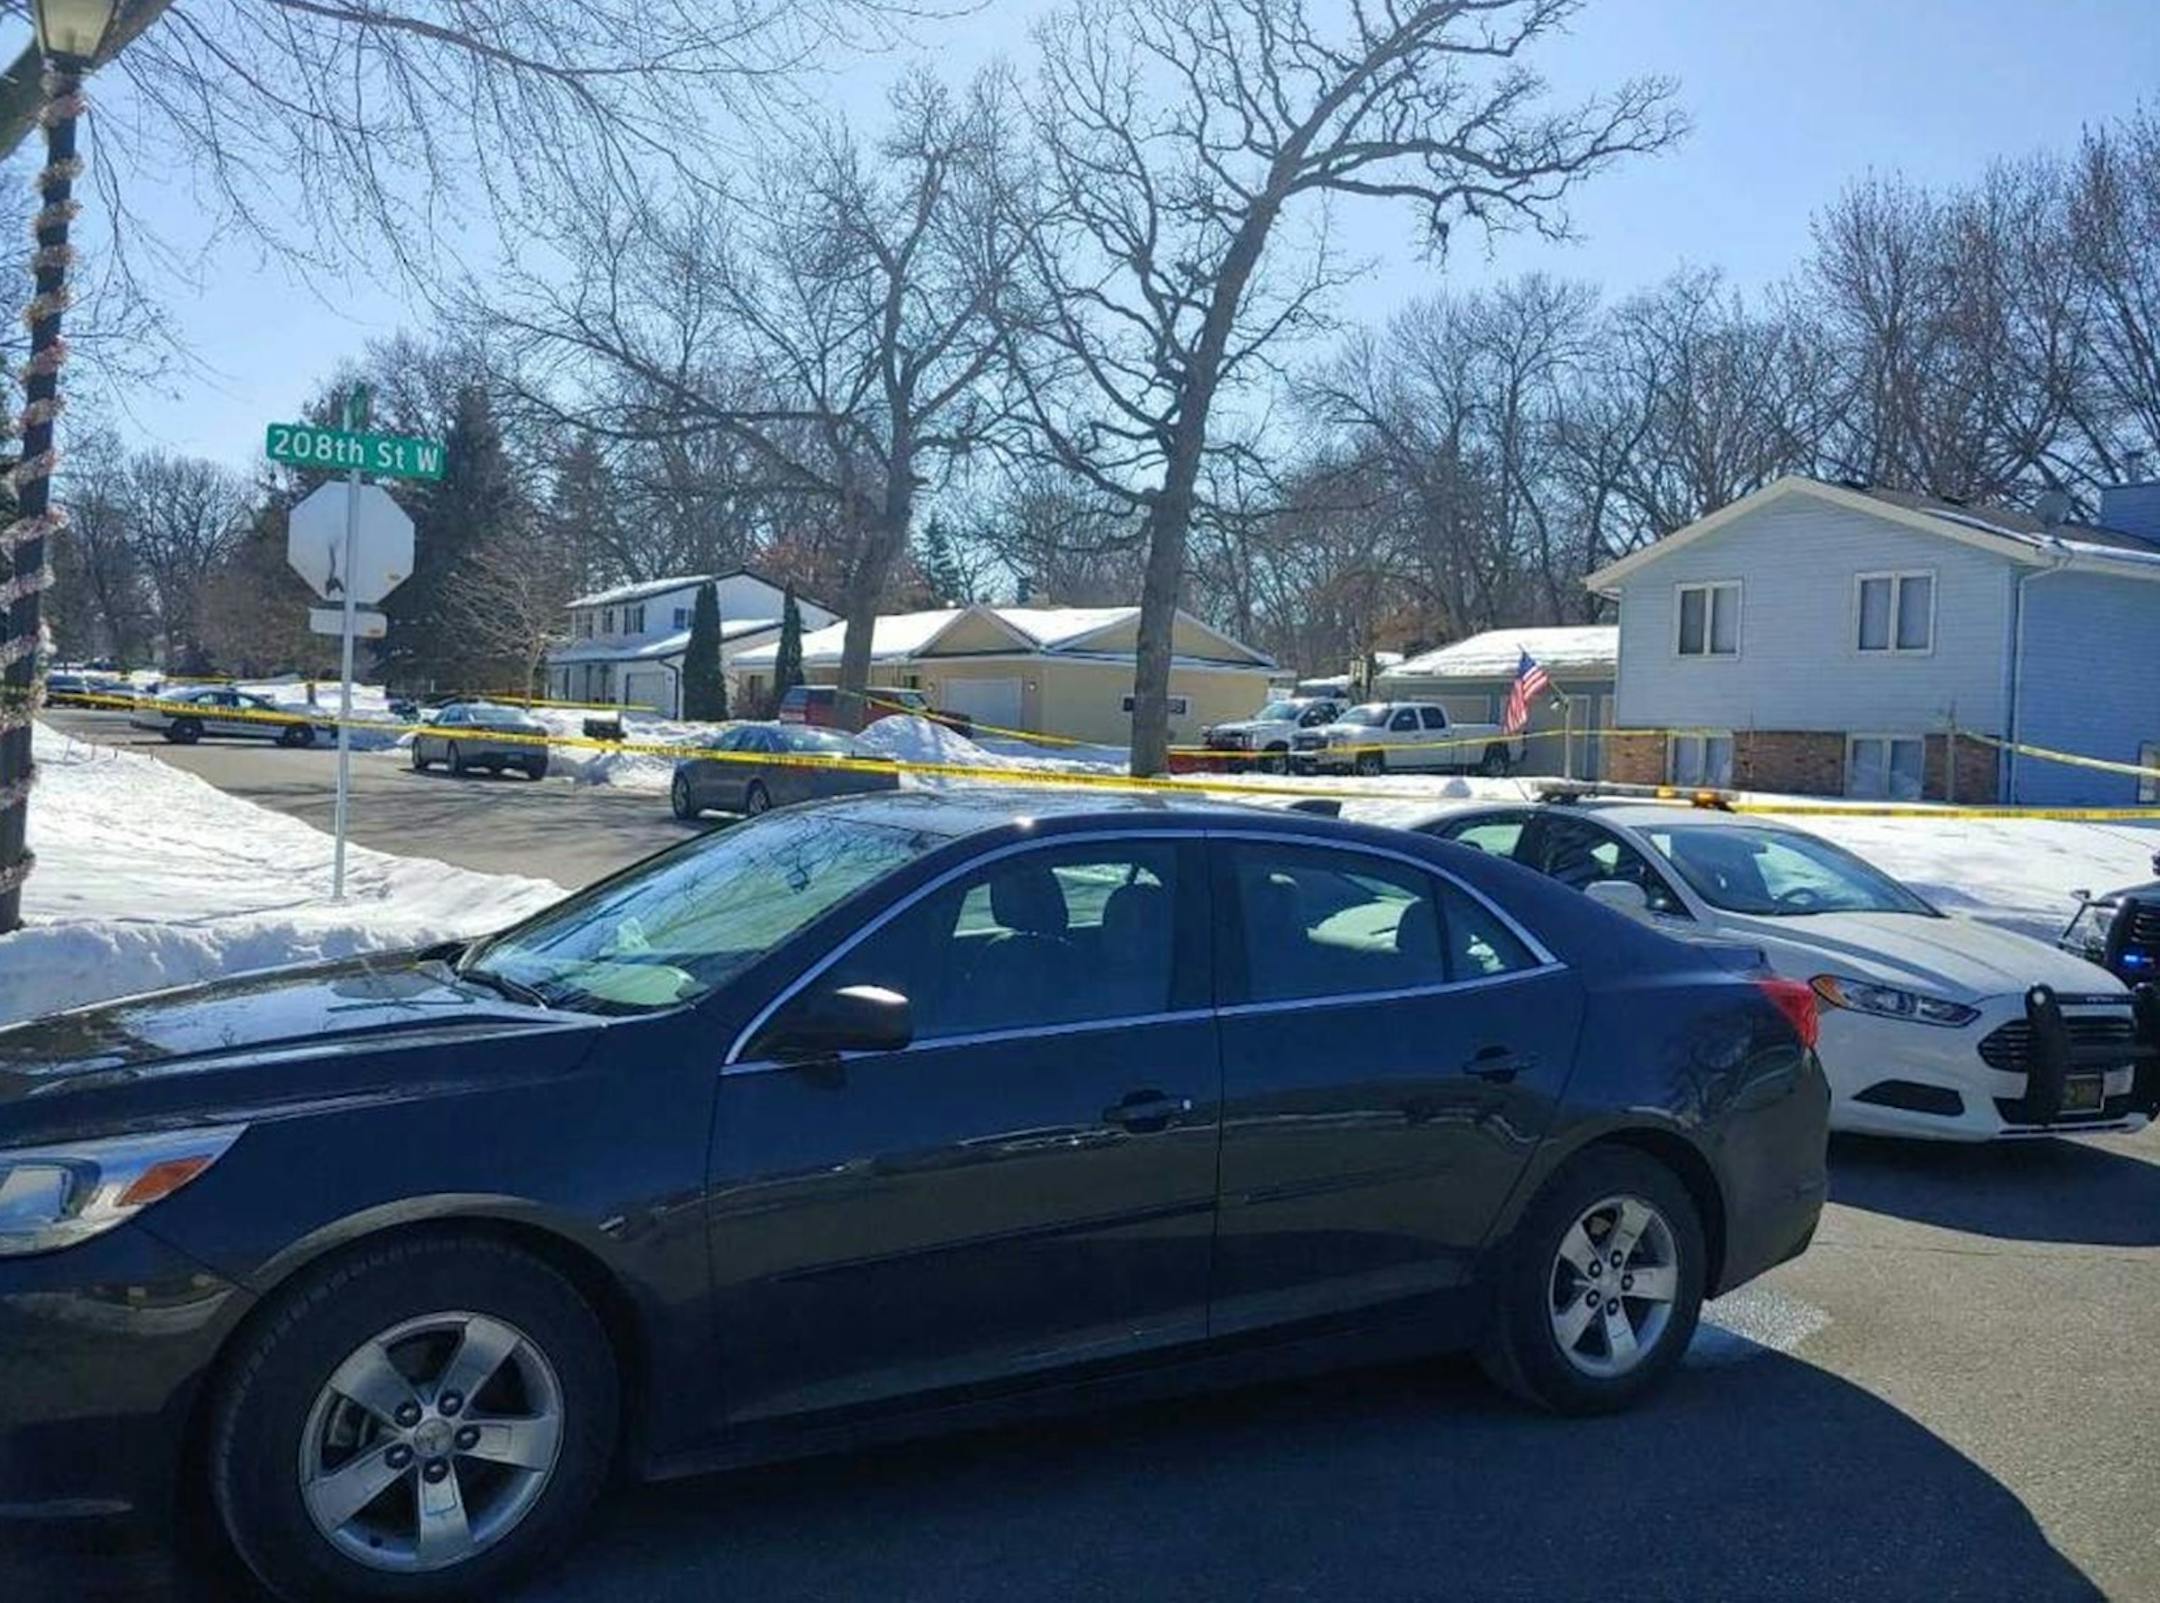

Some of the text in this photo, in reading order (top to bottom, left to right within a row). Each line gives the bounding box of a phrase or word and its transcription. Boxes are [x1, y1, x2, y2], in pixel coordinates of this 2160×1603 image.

[273, 429, 439, 472] 208th St W
